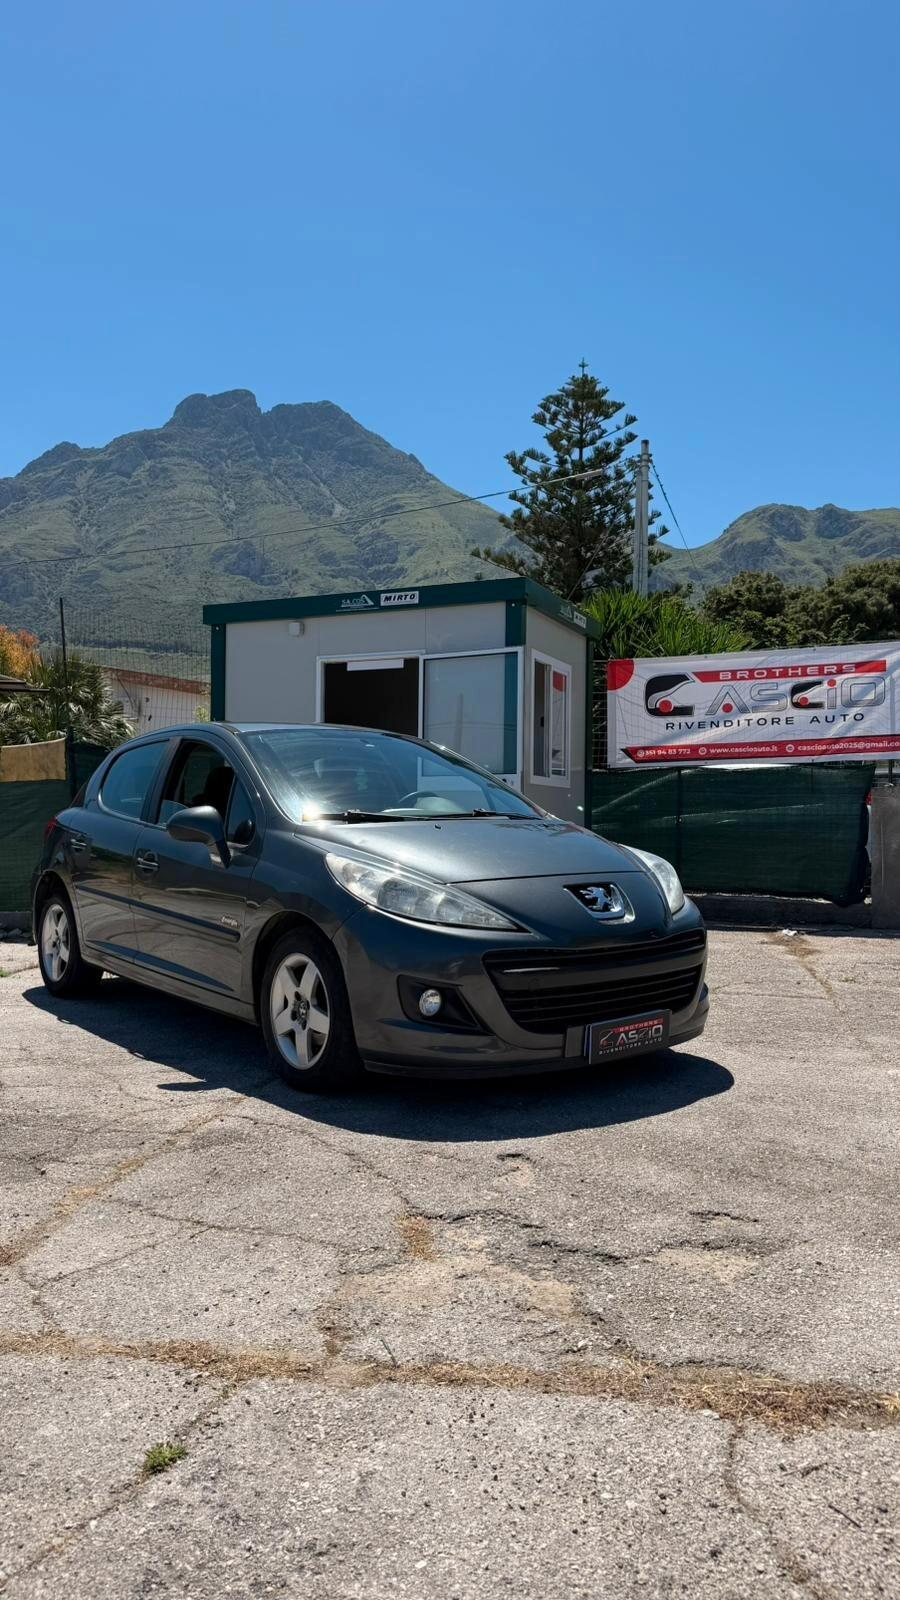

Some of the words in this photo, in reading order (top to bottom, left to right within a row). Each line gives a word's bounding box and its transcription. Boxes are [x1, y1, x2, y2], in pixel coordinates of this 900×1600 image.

[383, 593, 416, 602] MIRTO
[719, 664, 857, 680] BROTHERS
[665, 716, 795, 731] RIVENDITORE
[809, 713, 864, 725] AUTO
[709, 740, 778, 753] www.cascioauto.it
